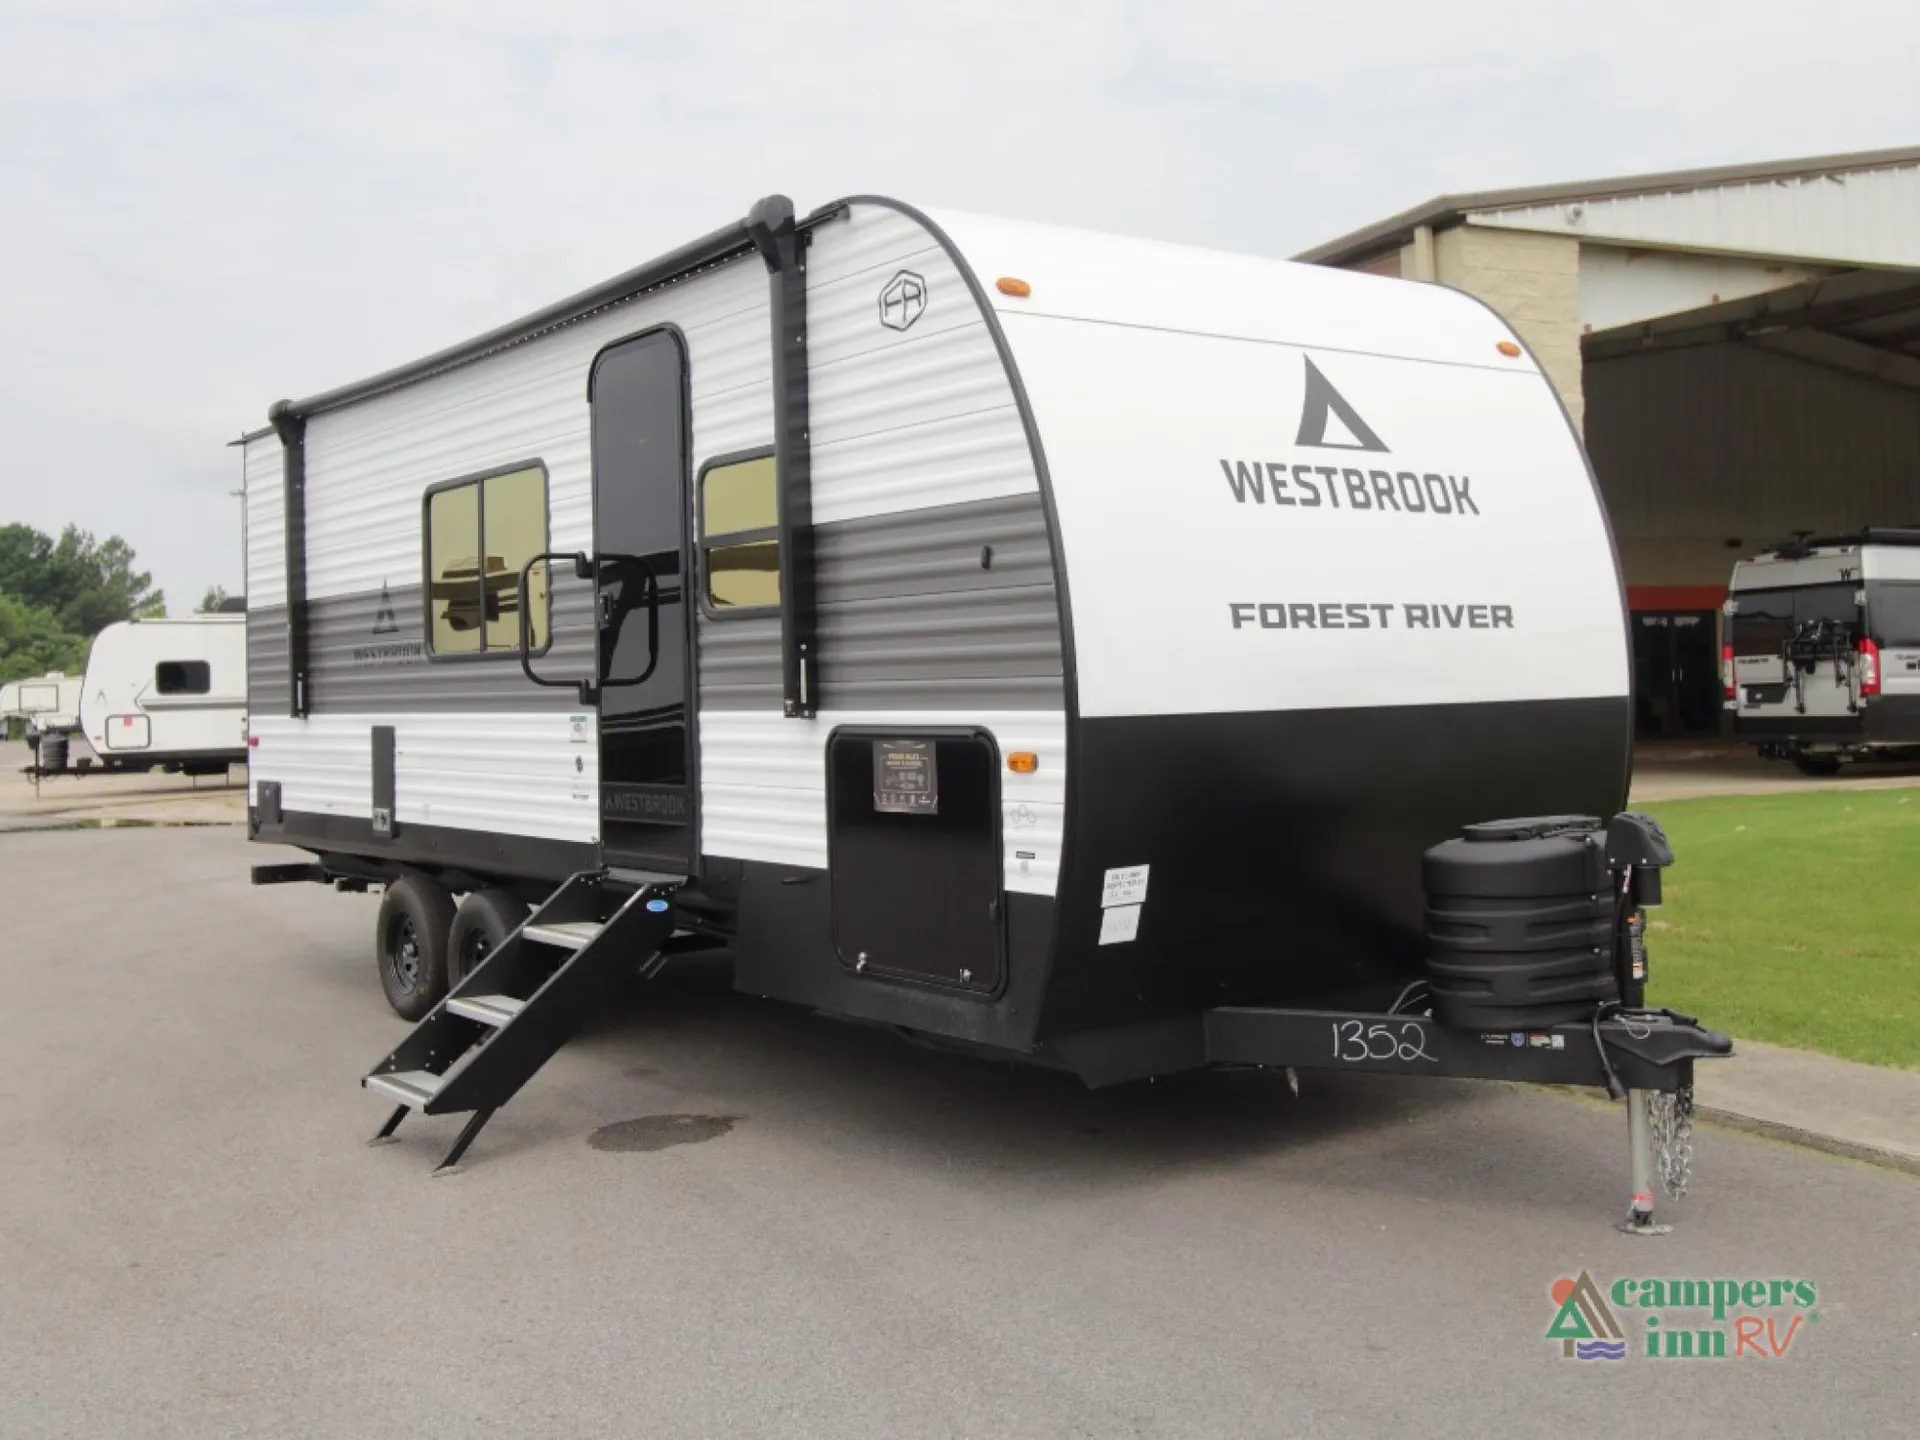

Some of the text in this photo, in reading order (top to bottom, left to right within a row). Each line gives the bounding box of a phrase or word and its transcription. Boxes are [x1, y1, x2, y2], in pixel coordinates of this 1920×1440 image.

[1219, 458, 1480, 515] WESTBROOK
[1229, 603, 1514, 629] FOREST RIVER
[1332, 1019, 1440, 1062] 1352
